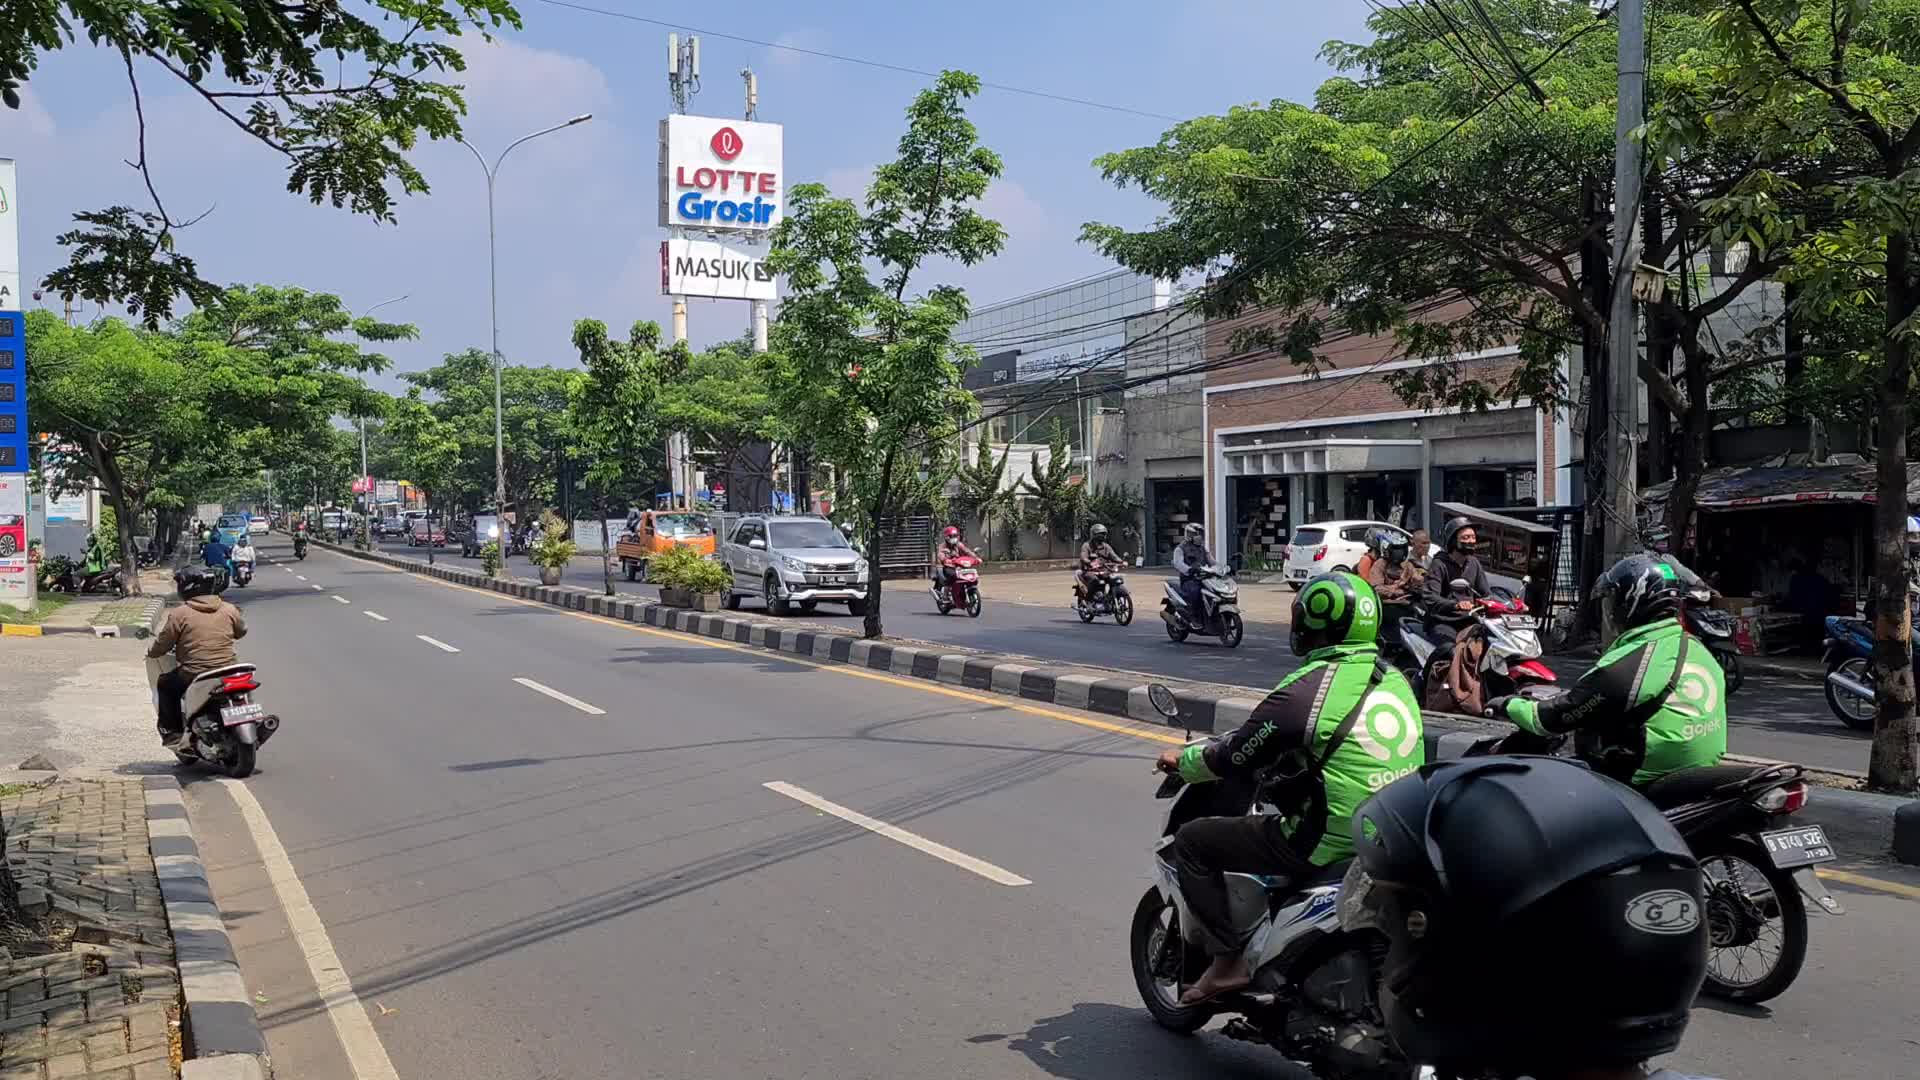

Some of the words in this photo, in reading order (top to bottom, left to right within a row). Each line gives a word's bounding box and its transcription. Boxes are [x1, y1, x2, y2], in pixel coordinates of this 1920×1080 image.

[677, 166, 776, 193] LOTTE
[678, 192, 776, 224] Grosir
[675, 256, 750, 281] MASUK
[1242, 720, 1278, 756] gojek
[1682, 719, 1721, 741] gojek
